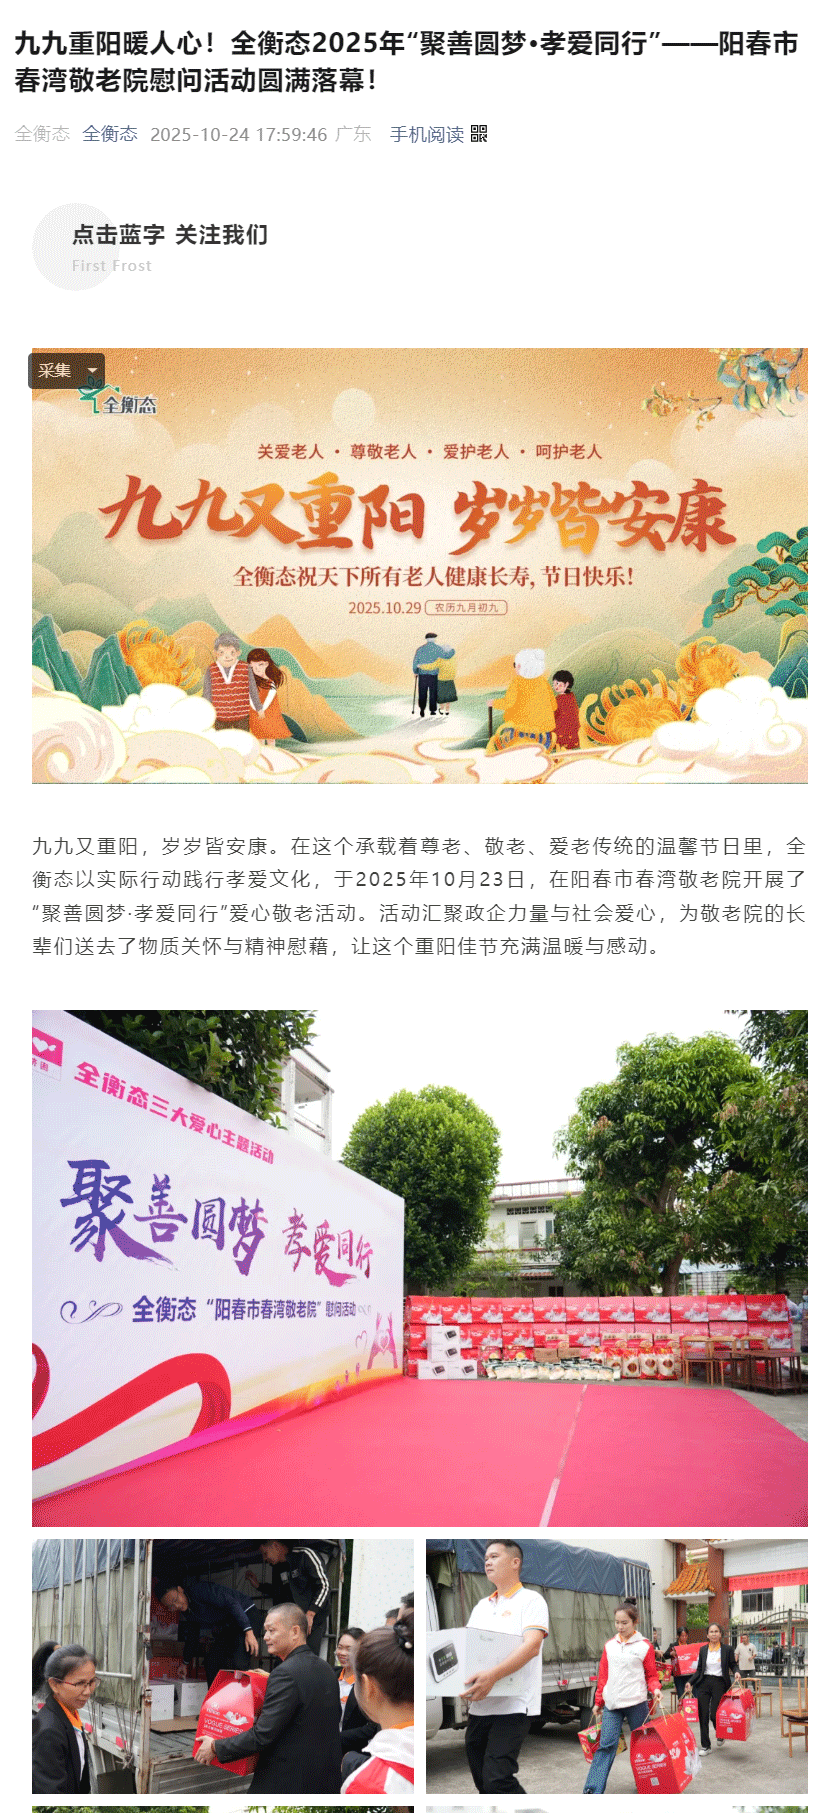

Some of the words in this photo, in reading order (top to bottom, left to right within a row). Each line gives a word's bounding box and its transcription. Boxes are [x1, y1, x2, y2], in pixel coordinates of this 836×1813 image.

[15, 67, 376, 93] 春湾敬老院慰问活动圆满落幕！
[15, 125, 70, 142] 全衡态
[82, 125, 138, 142] 全衡态
[151, 128, 250, 141] 2025-10-24
[257, 128, 327, 141] 17:59:46
[335, 125, 371, 142] 广东
[390, 125, 464, 143] 手机阅读
[73, 224, 164, 245] 点击蓝字
[176, 224, 267, 245] 关注我们
[73, 260, 106, 271] First
[113, 260, 151, 271] Frost
[103, 396, 157, 414] 全衡态
[98, 471, 426, 550] 九九又重阳
[448, 478, 737, 556] 岁岁皆安康
[348, 601, 422, 615] 2025.10.29
[434, 602, 499, 614] 农历九月初九
[33, 937, 656, 956] 辈们送去了物质关怀与精神慰藉，让这个重阳佳节充满温暖与感动。
[73, 1061, 275, 1165] 全衡态三大爱心主题活动
[60, 1160, 269, 1277] 聚善圆梦
[282, 1207, 375, 1288] 孝爱同行
[132, 1295, 197, 1323] 全衡态
